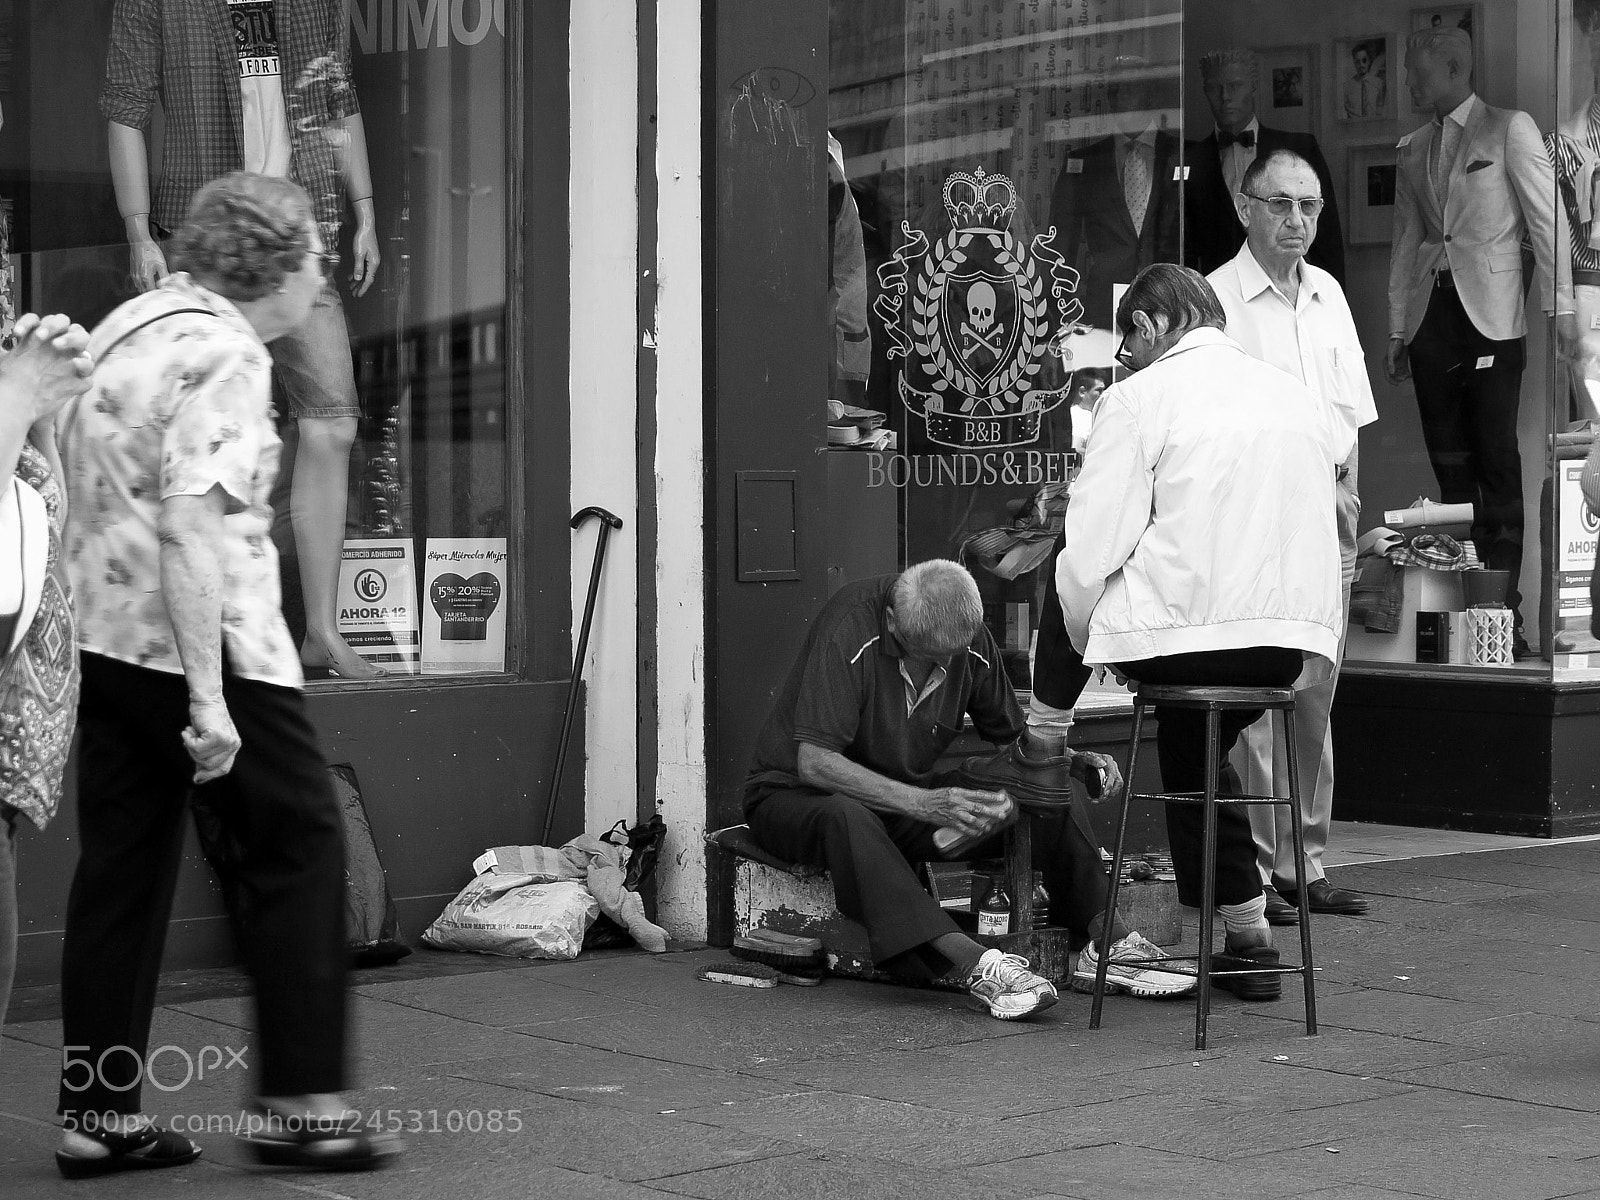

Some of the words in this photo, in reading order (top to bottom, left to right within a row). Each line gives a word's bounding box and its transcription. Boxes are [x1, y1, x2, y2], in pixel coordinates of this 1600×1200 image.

[1079, 0, 1088, 28] olive
[350, 0, 505, 54] NIMO
[239, 59, 278, 74] FORT
[1046, 43, 1056, 77] oliver
[1029, 146, 1039, 180] oliver
[964, 421, 1001, 442] B&B
[866, 450, 1084, 488] BOUNDS&BEE
[341, 551, 370, 559] OMERCIO
[371, 550, 402, 558] ADHERIDO
[1567, 541, 1597, 554] AHOR
[485, 550, 507, 564] Mujer
[437, 586, 456, 598] 15%
[457, 586, 480, 596] 20%
[340, 607, 389, 619] AHORA
[391, 606, 406, 617] 12
